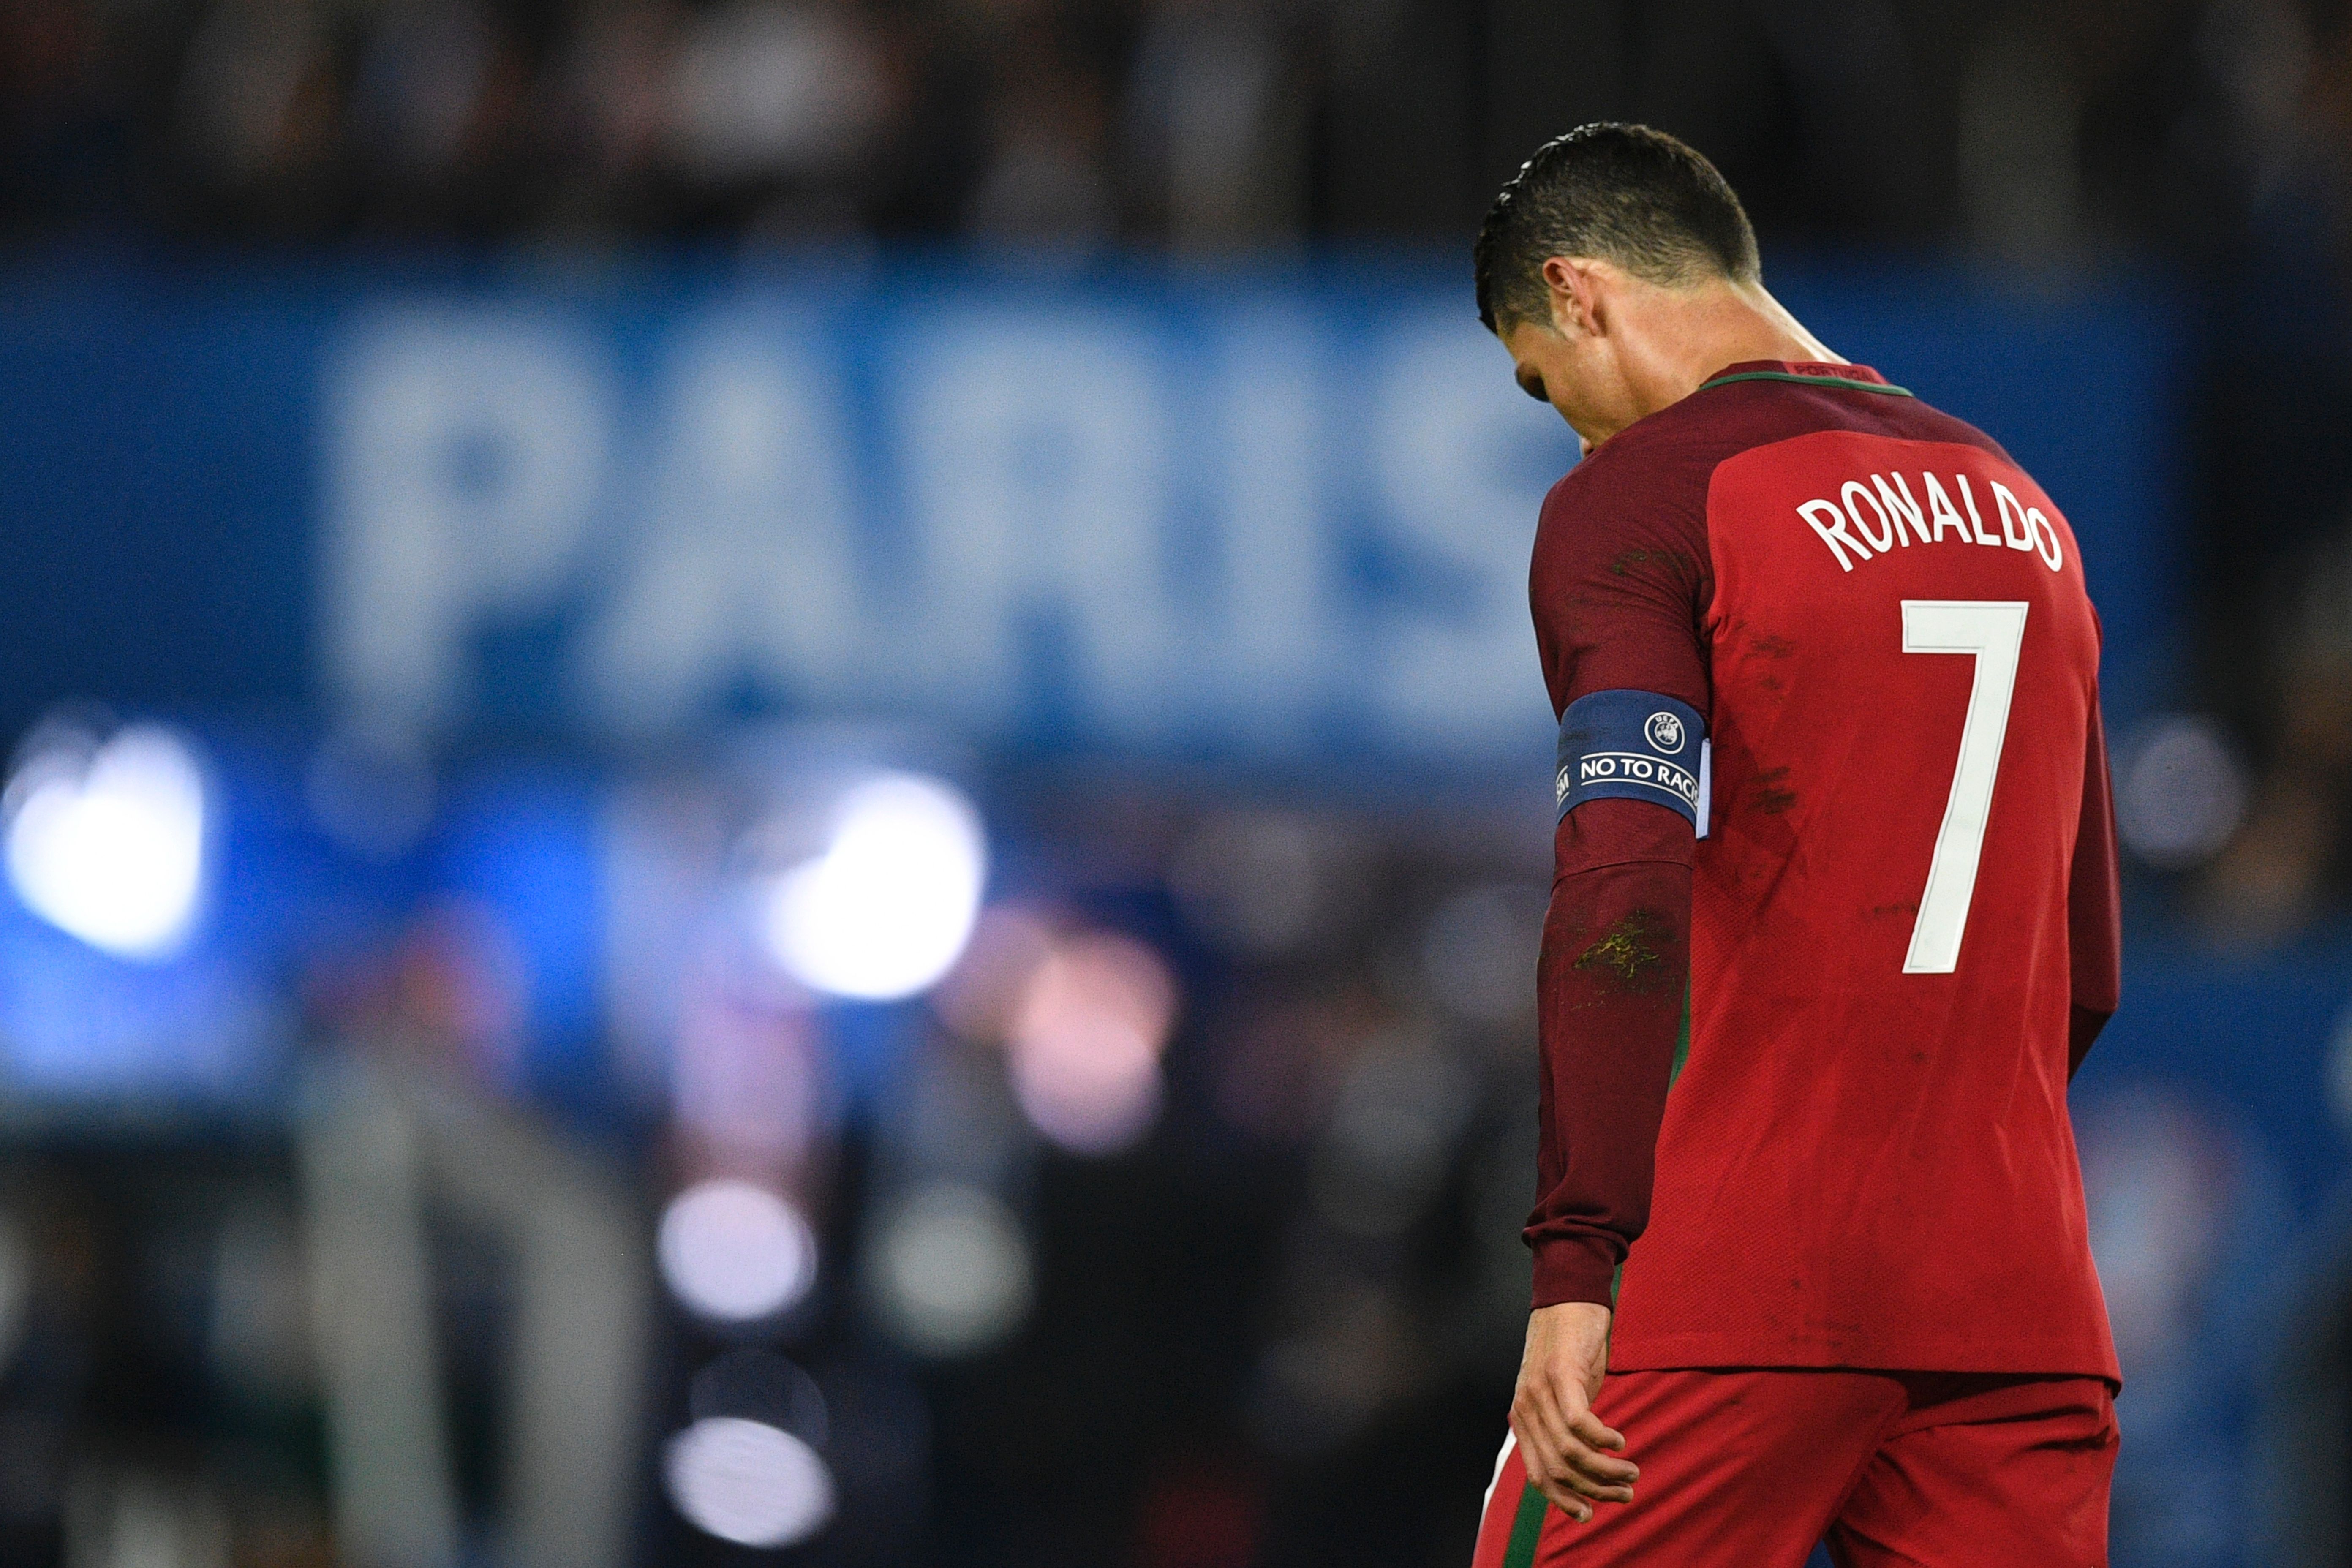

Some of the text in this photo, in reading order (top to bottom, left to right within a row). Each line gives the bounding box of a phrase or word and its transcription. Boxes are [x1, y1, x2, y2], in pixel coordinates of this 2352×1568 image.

[323, 302, 1561, 733] PARIS
[1795, 471, 2063, 573] RONALDO
[1581, 758, 1616, 779] NO
[1620, 758, 1652, 778] TO
[1655, 715, 1679, 730] UEFA
[1900, 600, 2029, 973] 7
